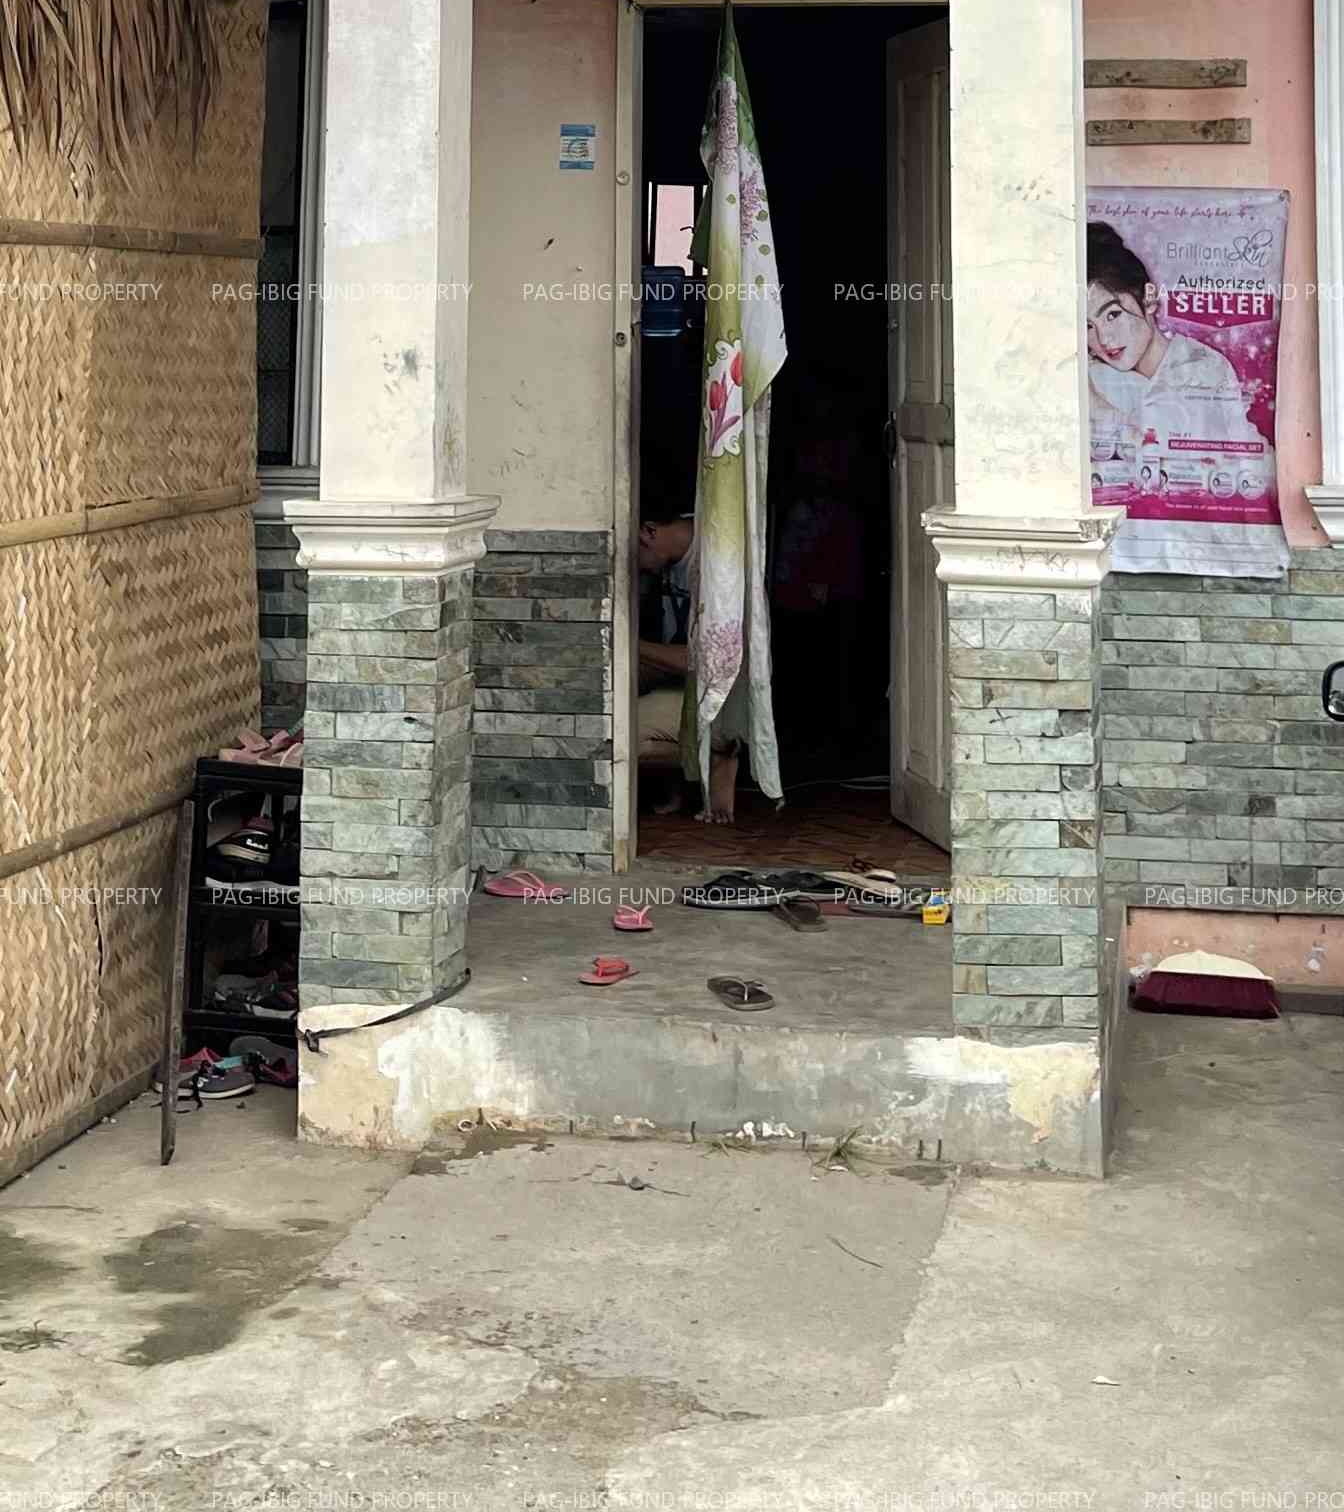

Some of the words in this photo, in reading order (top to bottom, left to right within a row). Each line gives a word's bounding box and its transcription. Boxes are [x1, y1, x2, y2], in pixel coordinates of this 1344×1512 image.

[1166, 241, 1228, 263] Brilliant
[1177, 273, 1266, 290] Authorized
[1175, 292, 1266, 316] SELLER
